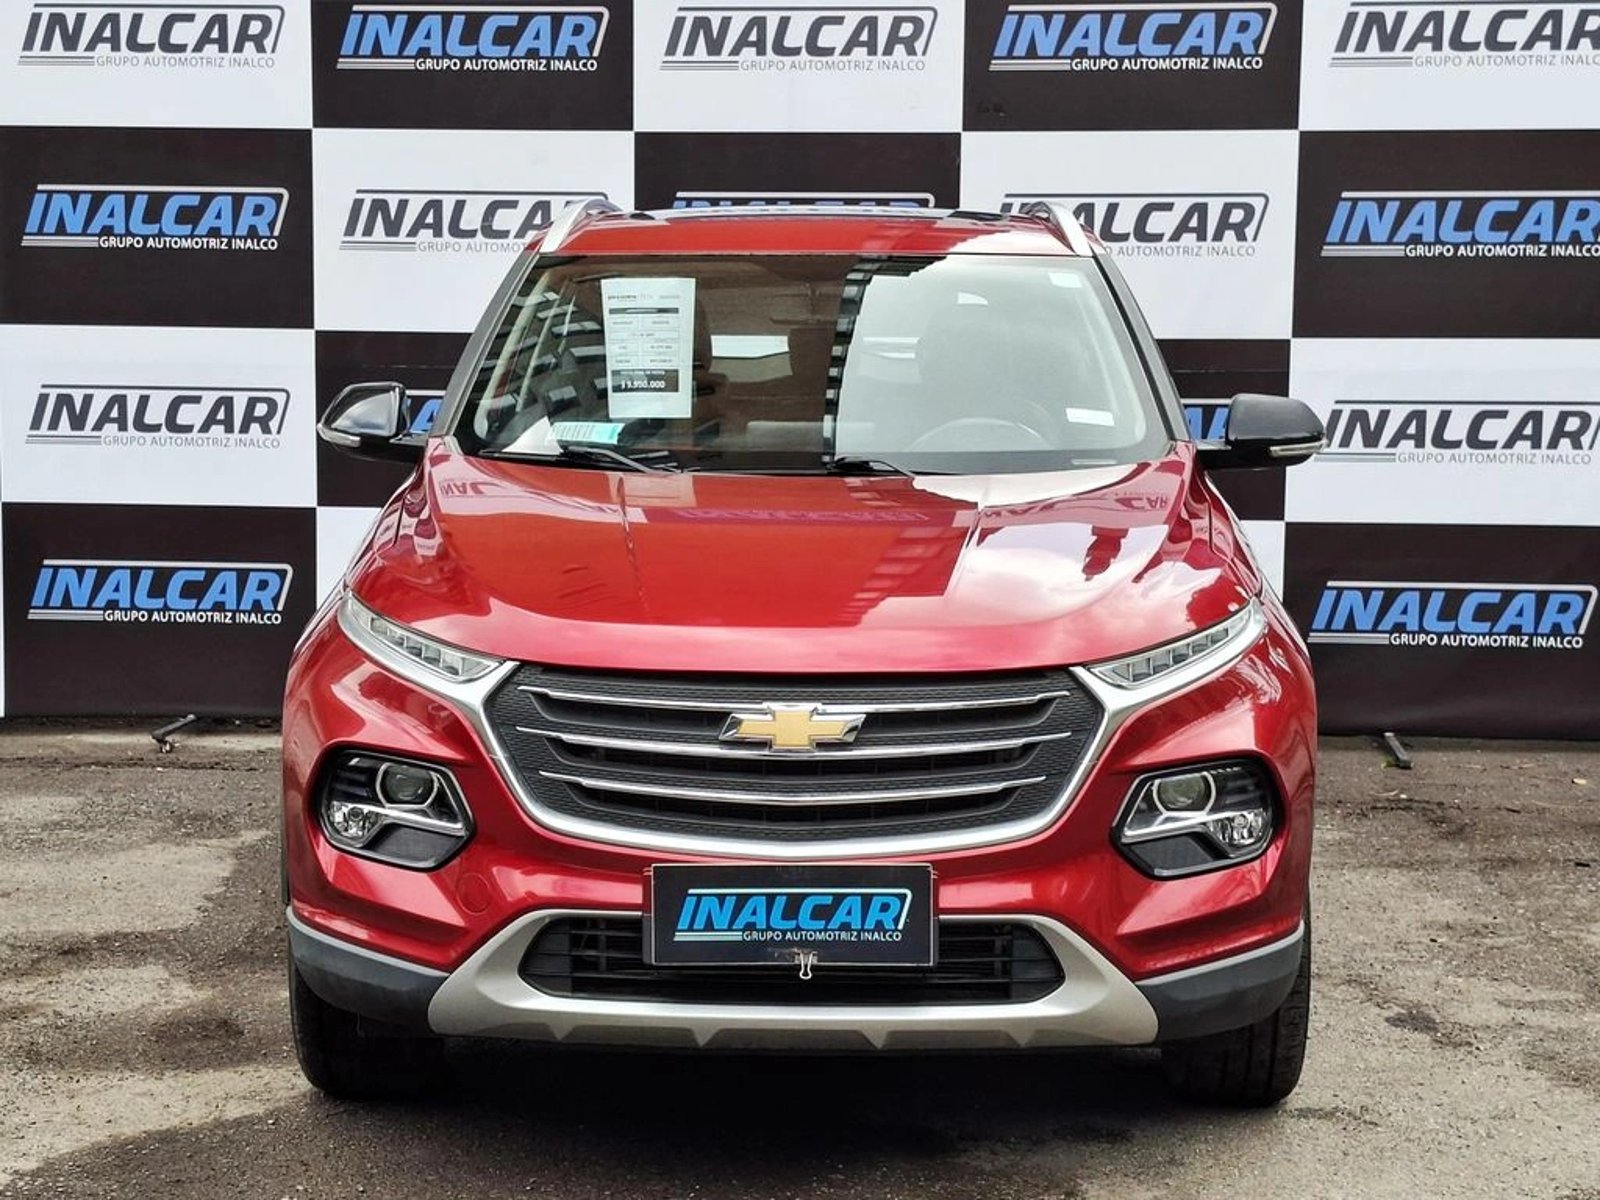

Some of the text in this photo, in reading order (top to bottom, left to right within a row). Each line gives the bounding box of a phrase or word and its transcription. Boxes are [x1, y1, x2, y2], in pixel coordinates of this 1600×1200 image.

[22, 13, 272, 53] INALCAR
[341, 14, 596, 57] INALCAR
[665, 16, 924, 57] INALCAR
[995, 12, 1263, 56] INALCAR
[1335, 9, 1600, 52] INALCAR
[96, 55, 276, 68] GRUPO AUTOMOTRIZ INALCO
[416, 58, 597, 71] GRUPO AUTOMOTRIZ INALCO
[740, 59, 925, 71] GRUPO AUTOMOTRIZ INALCO
[1072, 57, 1263, 71] GRUPO AUTOMOTRIZ INALCO
[1414, 54, 1600, 67] GRUPO AUTOMOTRIZ INALC
[26, 194, 276, 236] INALCAR
[344, 199, 578, 239] INALCA
[1327, 200, 1600, 243] INALCAR
[100, 236, 278, 250] GRUPO AUTOMOTRIZ INALCO
[418, 241, 461, 253] GRUPO
[1117, 245, 1202, 257] AUTOMOTRIZ
[1207, 245, 1255, 257] INALCO
[1406, 244, 1600, 257] GRUPO AUTOMOTRIZ INALCO
[30, 393, 278, 434] INALCAR
[1325, 409, 1592, 450] INALCAR
[103, 435, 281, 449] GRUPO AUTOMOTRIZ INALCO
[1398, 451, 1592, 465] GRUPO AUTOMOTRIZ INALCO
[32, 568, 280, 610] INALCAR
[104, 611, 282, 625] GRUPO AUTOMOTRIZ INALCO
[1313, 590, 1583, 634] INALCAR
[1390, 633, 1584, 649] GRUPO AUTOMOTRIZ INALCO
[678, 896, 900, 930] INALCAR
[743, 930, 902, 942] GRUPO AUTOMOTRIZ INALCO
